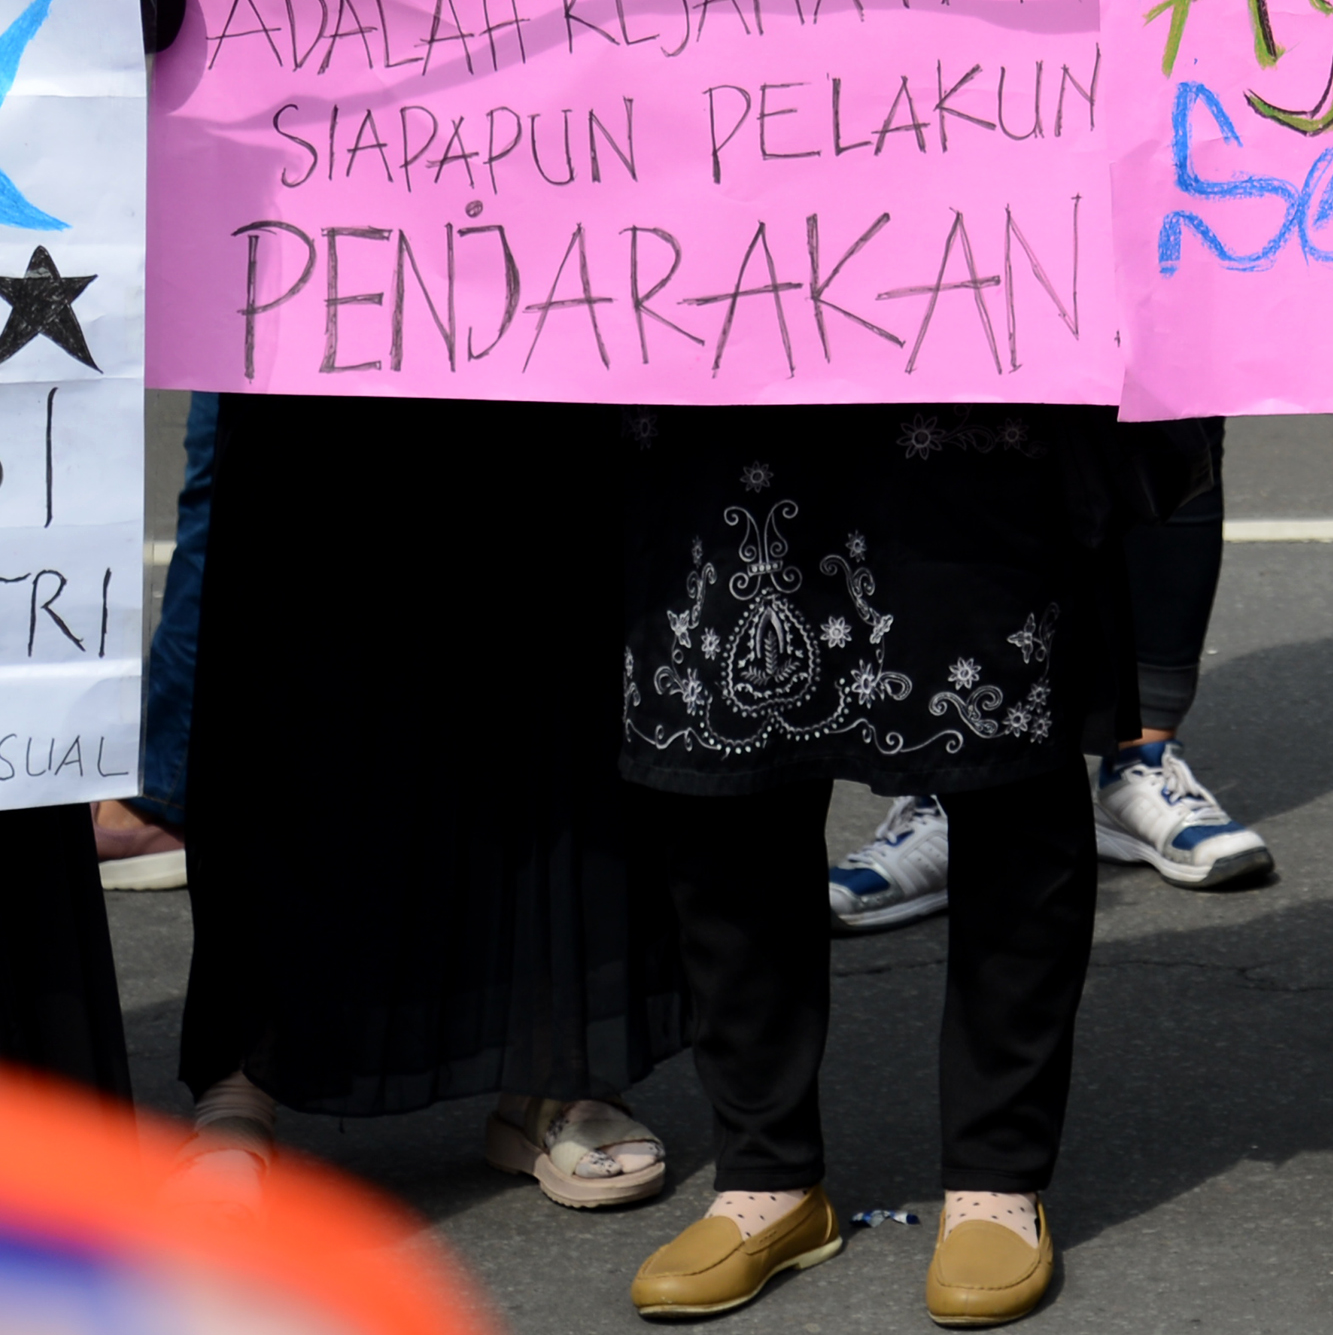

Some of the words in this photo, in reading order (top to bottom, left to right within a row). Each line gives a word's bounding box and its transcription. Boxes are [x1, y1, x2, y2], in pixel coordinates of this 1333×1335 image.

[273, 95, 639, 196] SIAPAPUN
[703, 45, 1101, 183] PELAKUN
[232, 192, 1083, 384] PENJARAKAN
